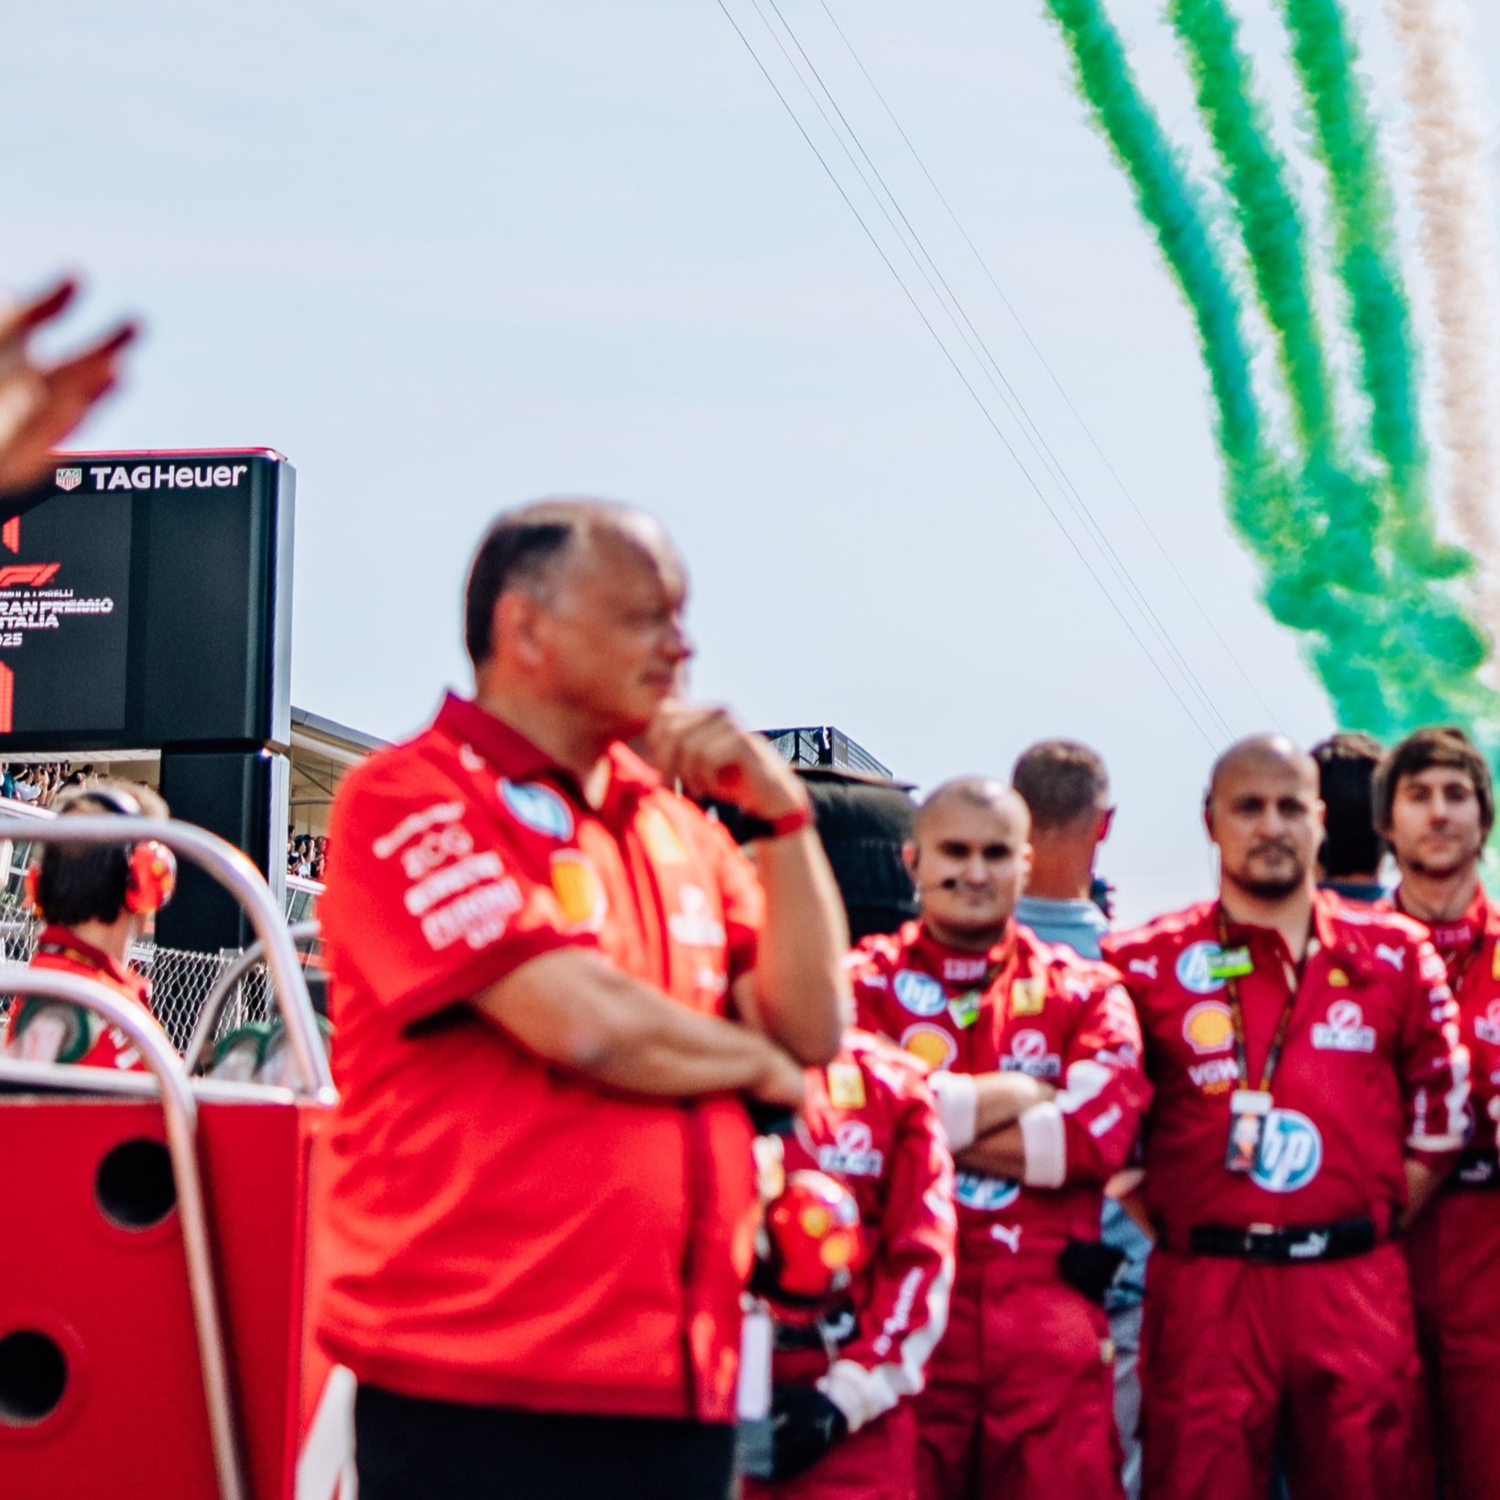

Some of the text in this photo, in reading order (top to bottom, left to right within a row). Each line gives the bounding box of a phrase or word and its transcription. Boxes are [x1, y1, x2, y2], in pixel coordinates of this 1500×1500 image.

[0, 597, 114, 616] RAN PREMIO
[0, 612, 60, 630] ITALIA
[1262, 1109, 1313, 1190] hp
